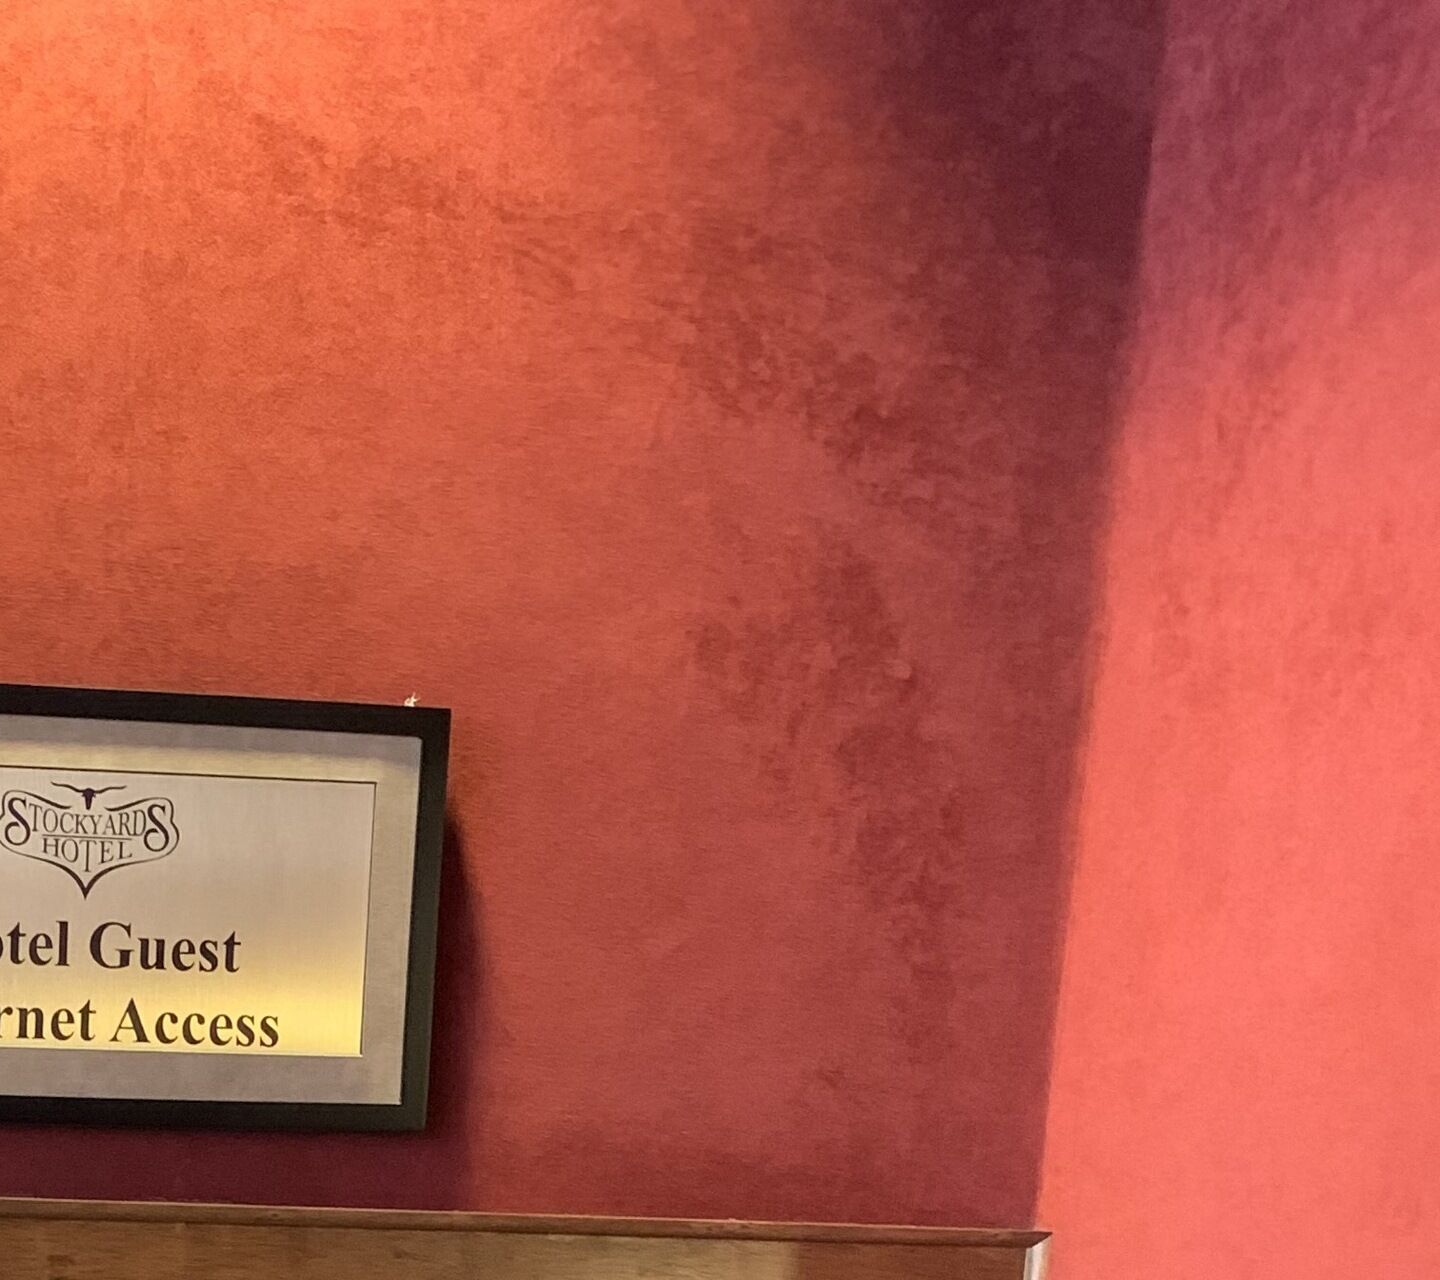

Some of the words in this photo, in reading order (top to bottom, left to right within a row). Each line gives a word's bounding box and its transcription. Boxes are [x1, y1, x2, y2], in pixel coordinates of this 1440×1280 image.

[4, 797, 170, 852] STOCKYARDS
[41, 837, 134, 873] HOTEL
[89, 921, 242, 973] Guest
[108, 997, 280, 1048] Access
